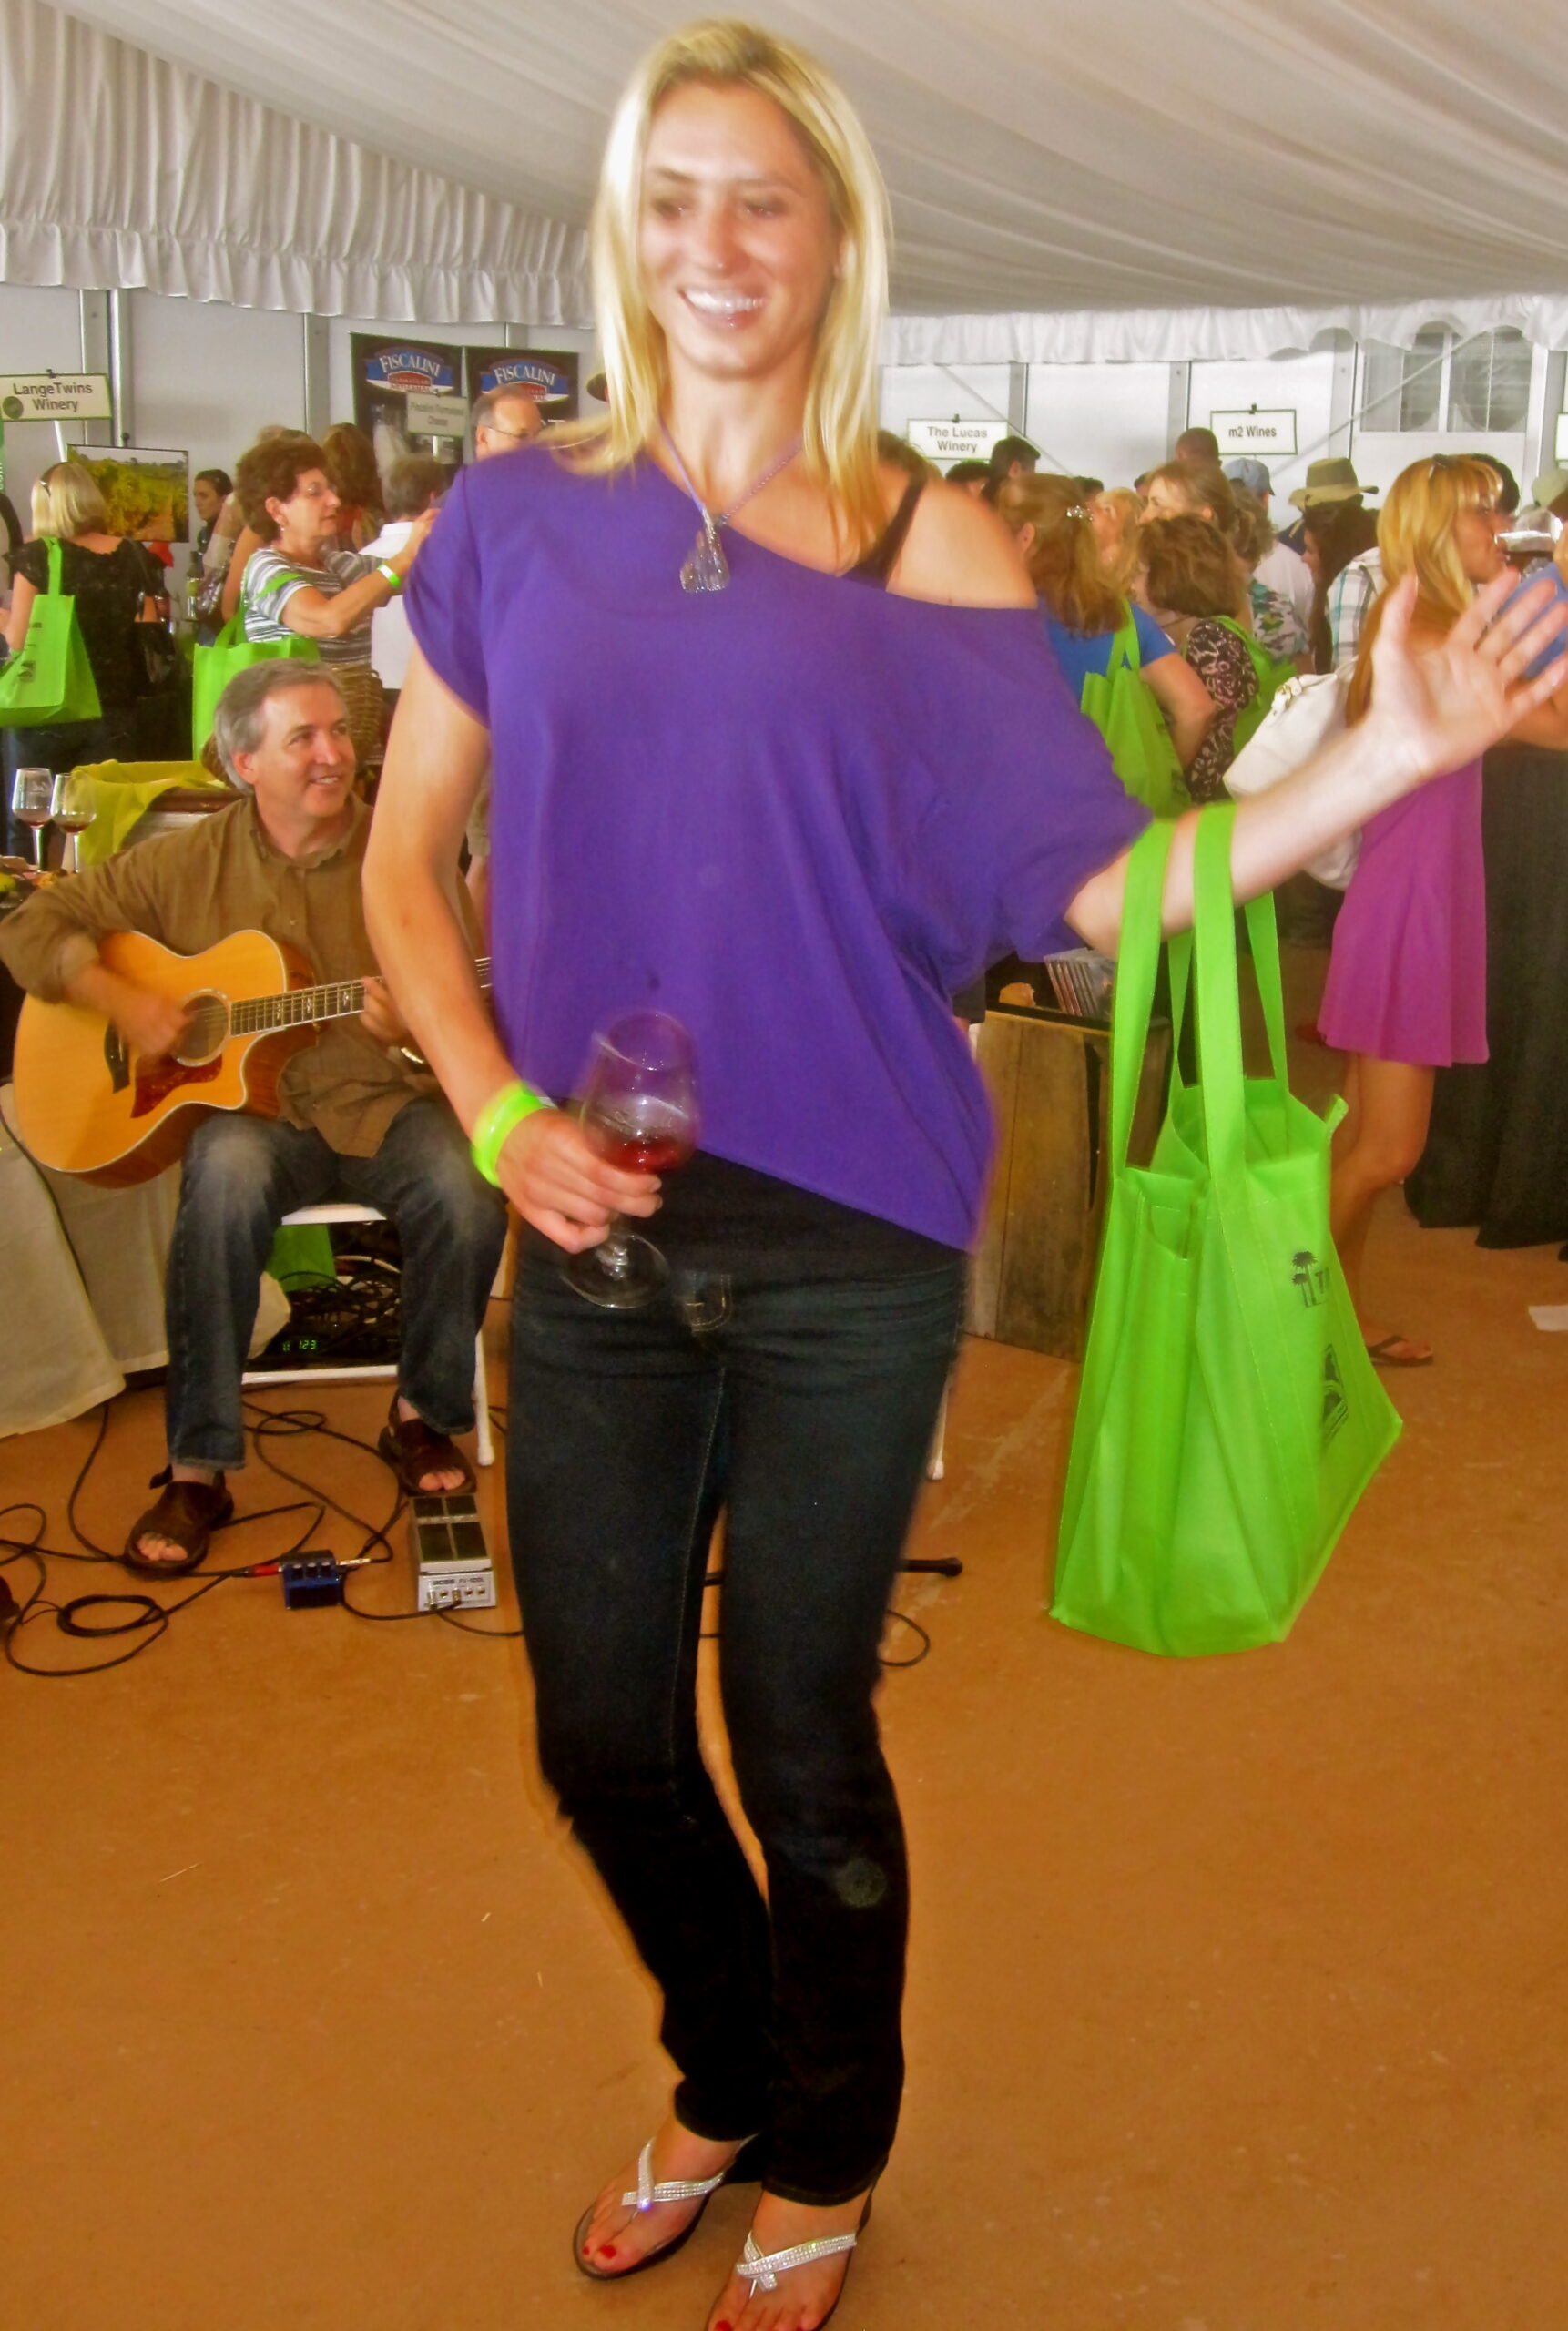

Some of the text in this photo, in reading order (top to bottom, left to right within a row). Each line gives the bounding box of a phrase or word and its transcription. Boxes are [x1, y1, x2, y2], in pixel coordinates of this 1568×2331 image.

[379, 354, 441, 377] FISCALINI
[494, 365, 556, 386] FISCALINI
[13, 382, 93, 397] LangeTwins
[32, 398, 78, 412] Winery
[927, 426, 988, 437] The Lucas
[1228, 426, 1277, 437] m2 Wines
[937, 441, 977, 453] Winery
